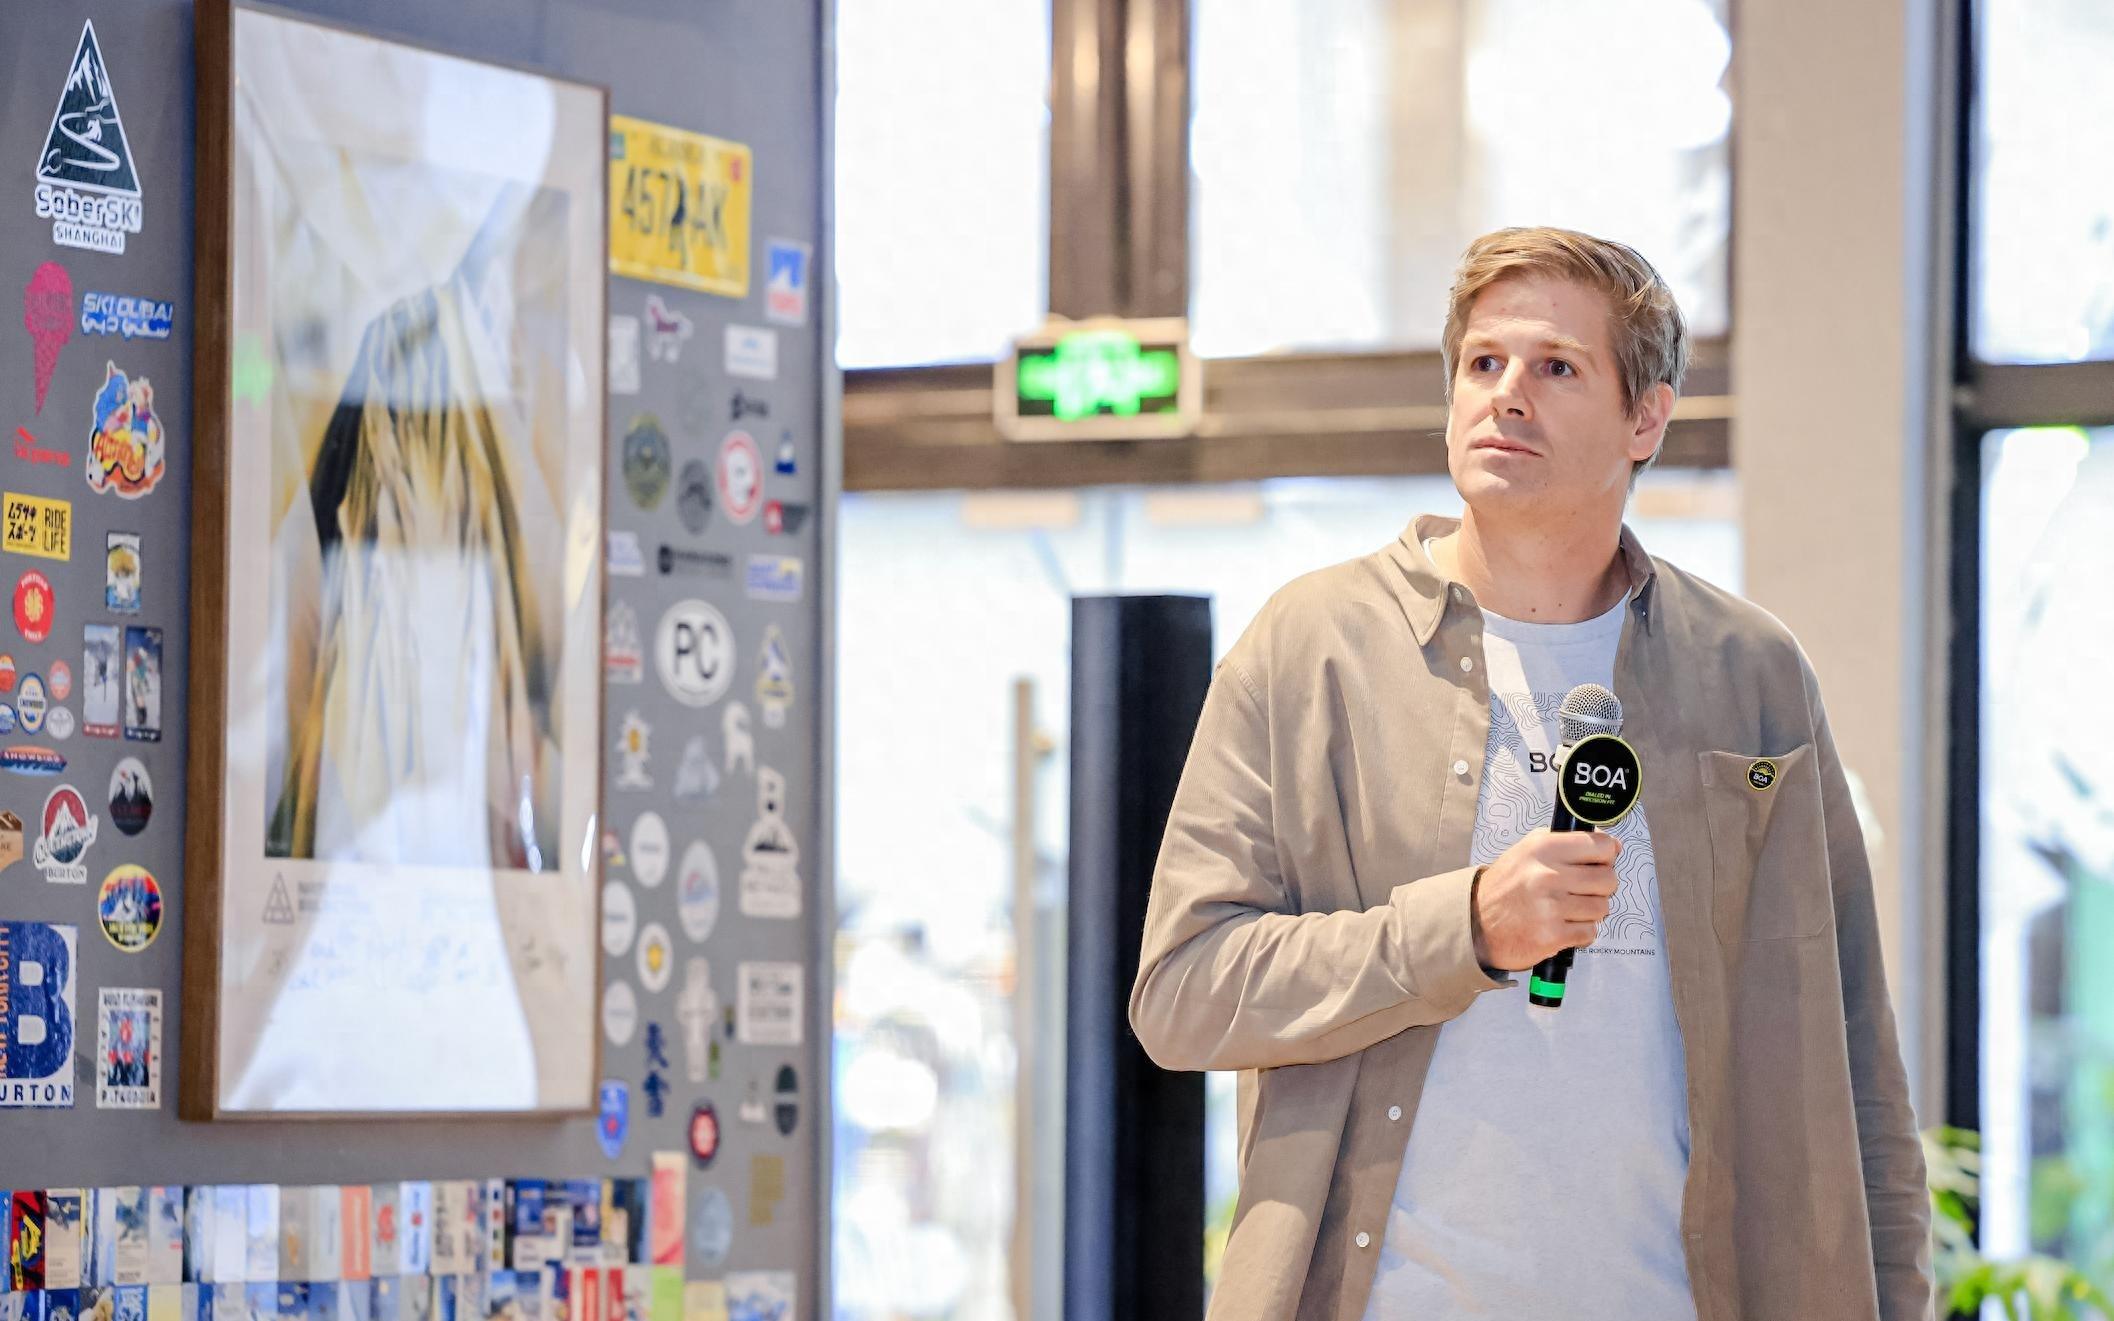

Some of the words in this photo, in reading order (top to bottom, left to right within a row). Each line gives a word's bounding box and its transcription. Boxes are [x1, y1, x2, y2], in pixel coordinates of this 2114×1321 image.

[56, 225, 123, 248] SHANGHAI
[83, 292, 115, 315] SKI
[45, 507, 67, 529] RIDE
[44, 530, 66, 554] LIFE
[674, 621, 719, 680] PC
[1574, 762, 1627, 791] BOA
[1753, 773, 1768, 784] BOA
[0, 1084, 71, 1102] URTON
